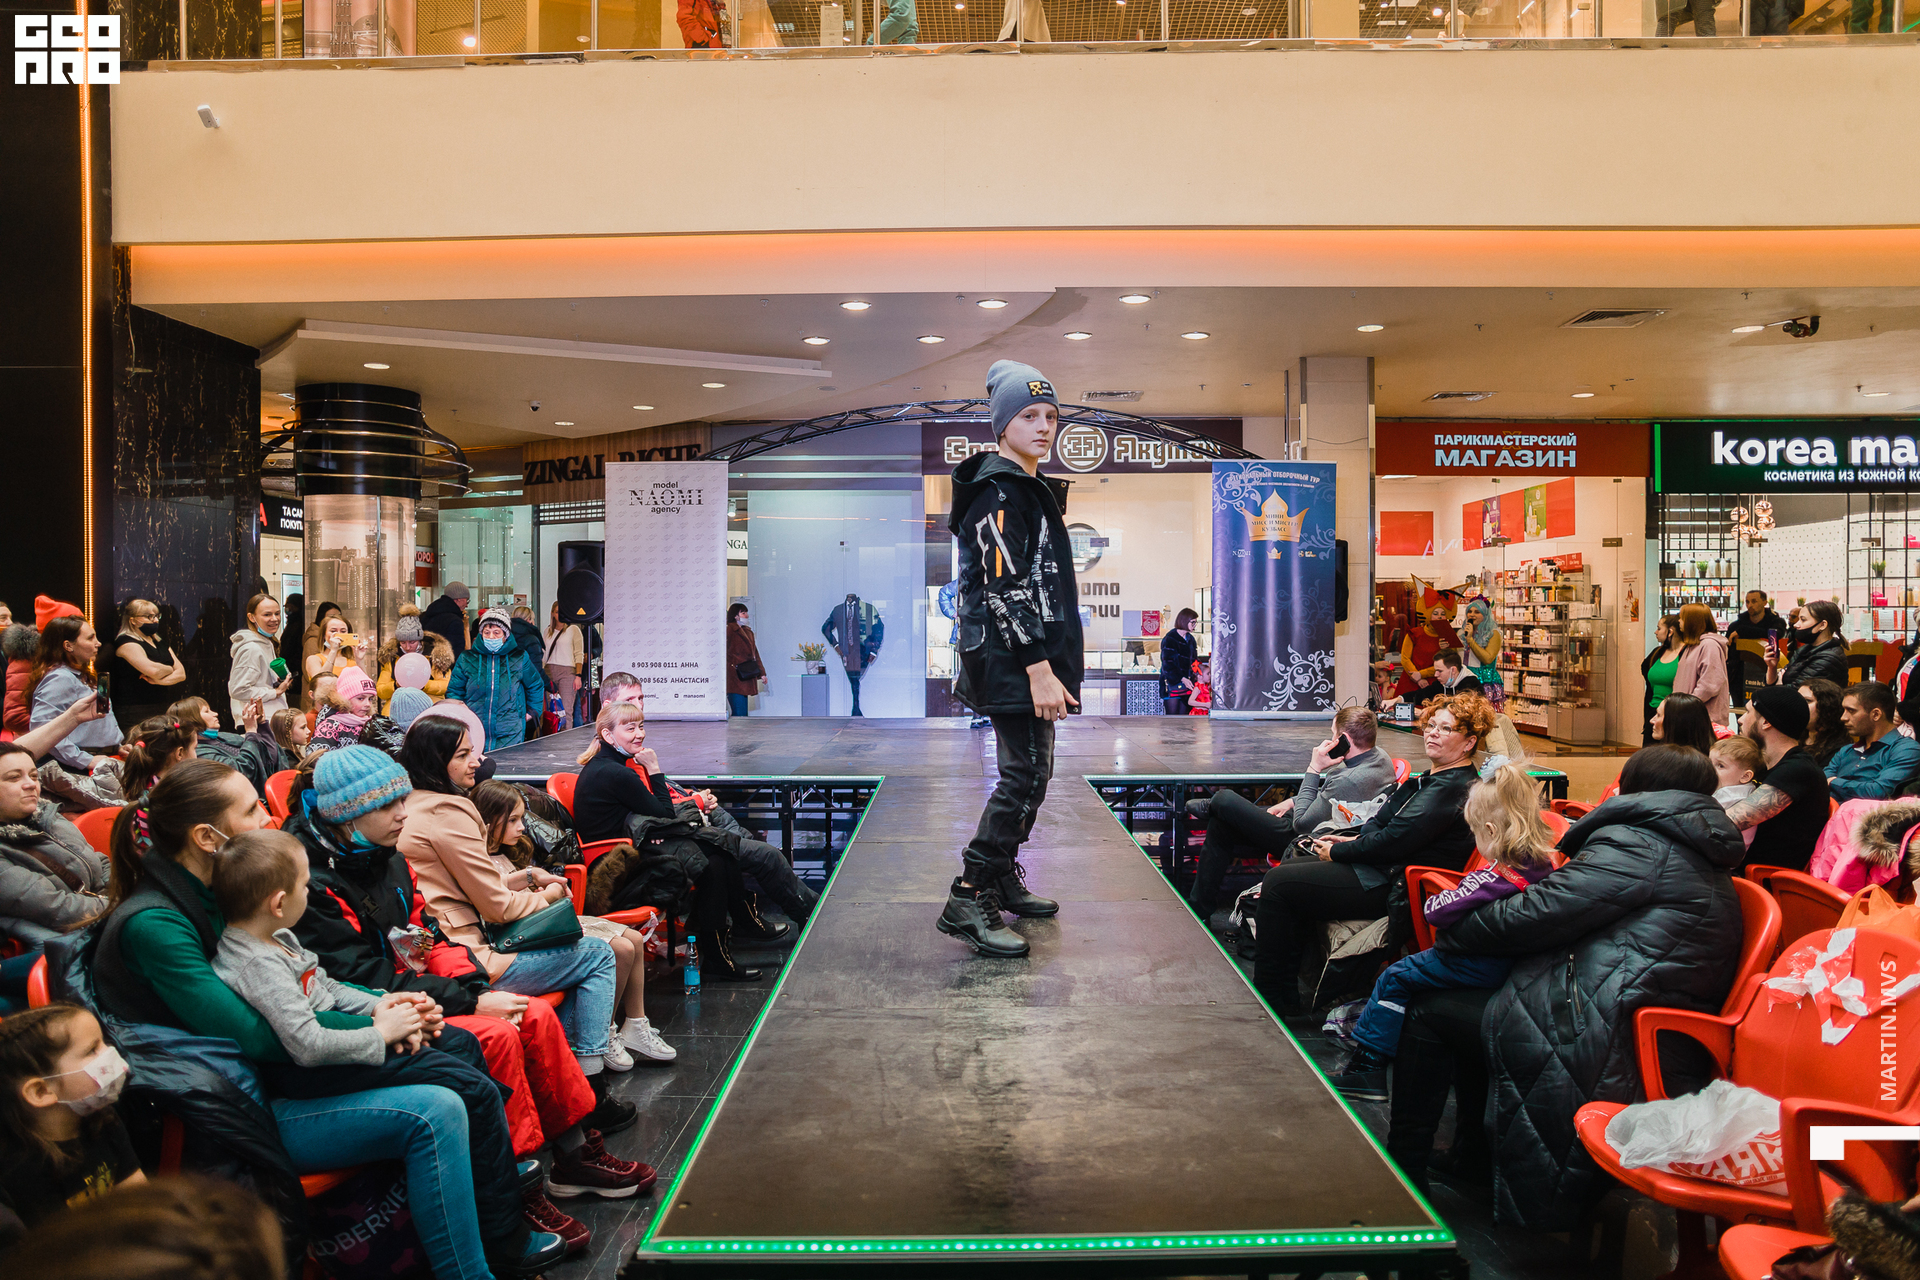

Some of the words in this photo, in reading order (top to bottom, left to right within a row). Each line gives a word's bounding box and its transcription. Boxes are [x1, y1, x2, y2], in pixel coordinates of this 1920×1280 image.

[1434, 433, 1577, 446] ПАРИКМАСТЕРСКИЙ
[1711, 430, 1838, 466] korea
[1848, 436, 1920, 466] ma
[1435, 449, 1577, 467] МАГАЗИН
[524, 454, 605, 485] ZINGAL
[1764, 470, 1835, 481] косметика
[1838, 471, 1854, 481] из
[1857, 468, 1905, 482] южной
[629, 489, 704, 506] NAOMI
[651, 506, 681, 514] agency
